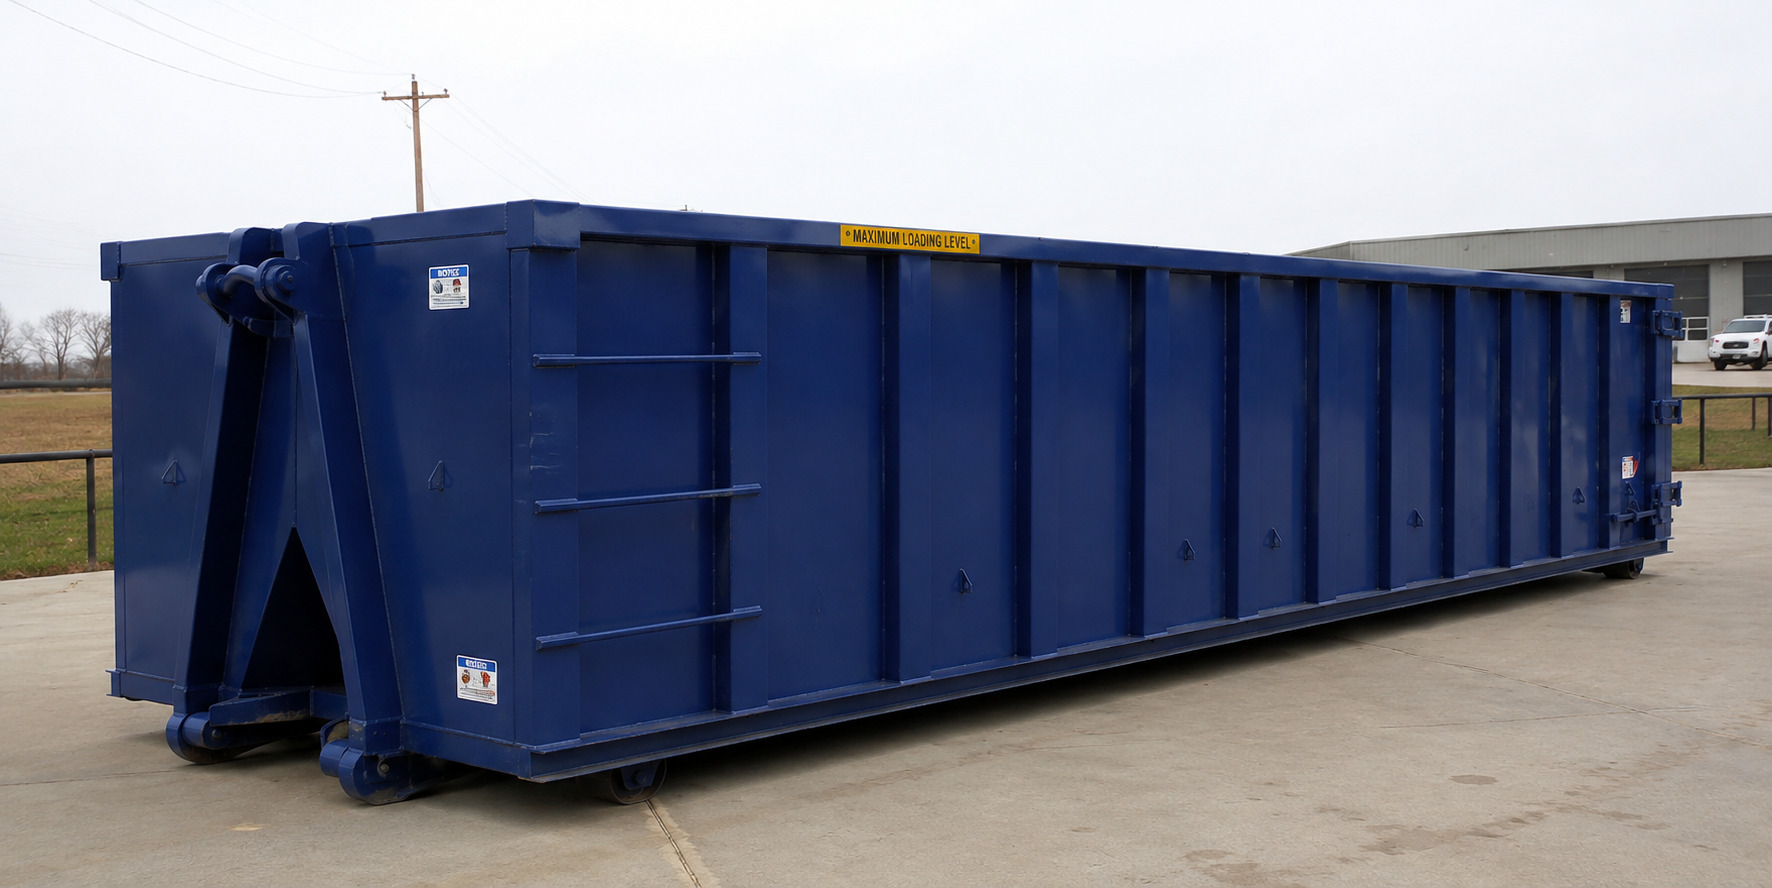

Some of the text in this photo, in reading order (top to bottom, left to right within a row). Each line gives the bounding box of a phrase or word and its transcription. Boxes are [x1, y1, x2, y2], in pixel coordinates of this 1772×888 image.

[853, 229, 971, 249] MAXIMUM LOADING LEVEL
